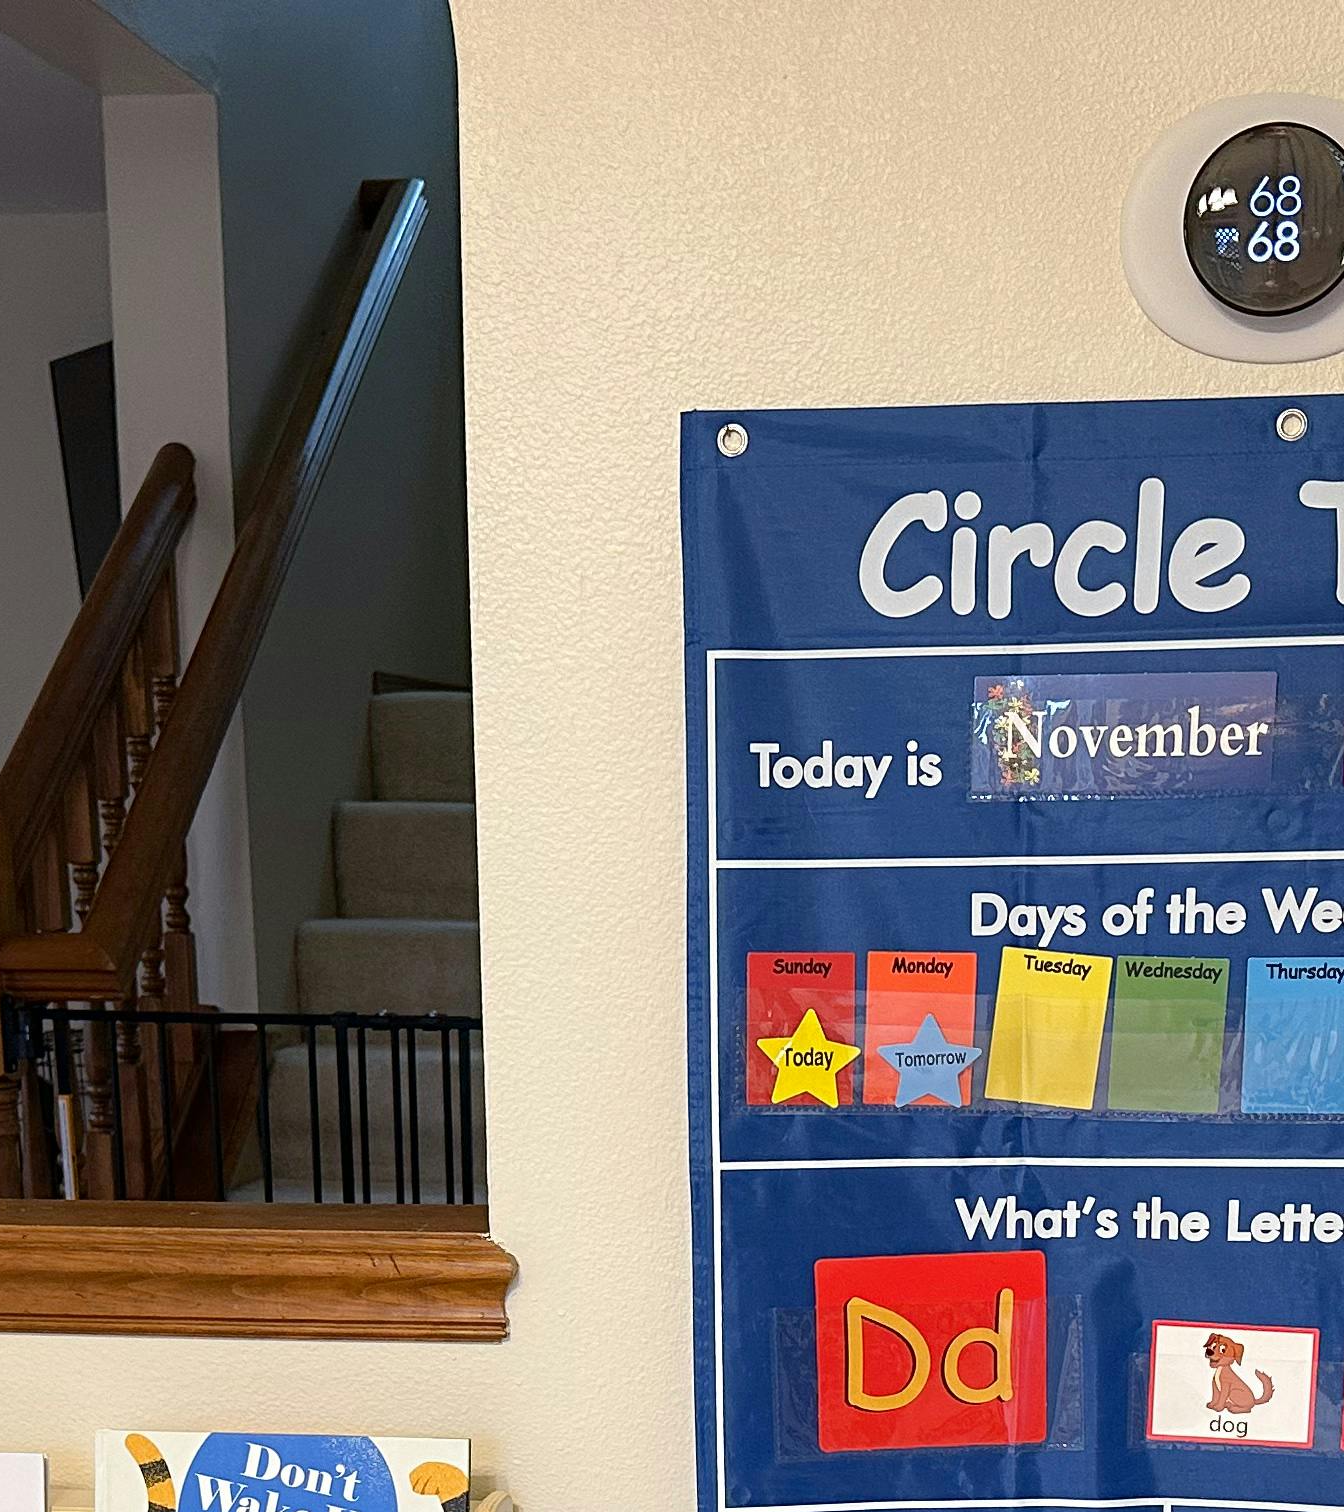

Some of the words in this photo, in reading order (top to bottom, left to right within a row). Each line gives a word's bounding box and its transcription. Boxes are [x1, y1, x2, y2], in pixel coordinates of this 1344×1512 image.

[1250, 176, 1302, 216] 68
[1247, 221, 1300, 262] 68
[858, 477, 1251, 618] Circle
[749, 740, 892, 798] Today
[906, 740, 942, 787] is
[1002, 705, 1269, 758] November
[971, 892, 1086, 945] Days
[1101, 888, 1157, 935] of
[1166, 888, 1247, 935] the
[772, 959, 832, 978] Sunday
[892, 958, 953, 979] Monday
[1024, 955, 1091, 980] Tuesday
[1125, 961, 1223, 985] Wednesday
[784, 1048, 833, 1069] Today
[895, 1051, 967, 1067] Tomorrow
[956, 1198, 1118, 1243] What's
[1132, 1198, 1210, 1243] the
[846, 1288, 1014, 1412] Dd
[1209, 1416, 1249, 1438] dog
[241, 1442, 361, 1502] Don't
